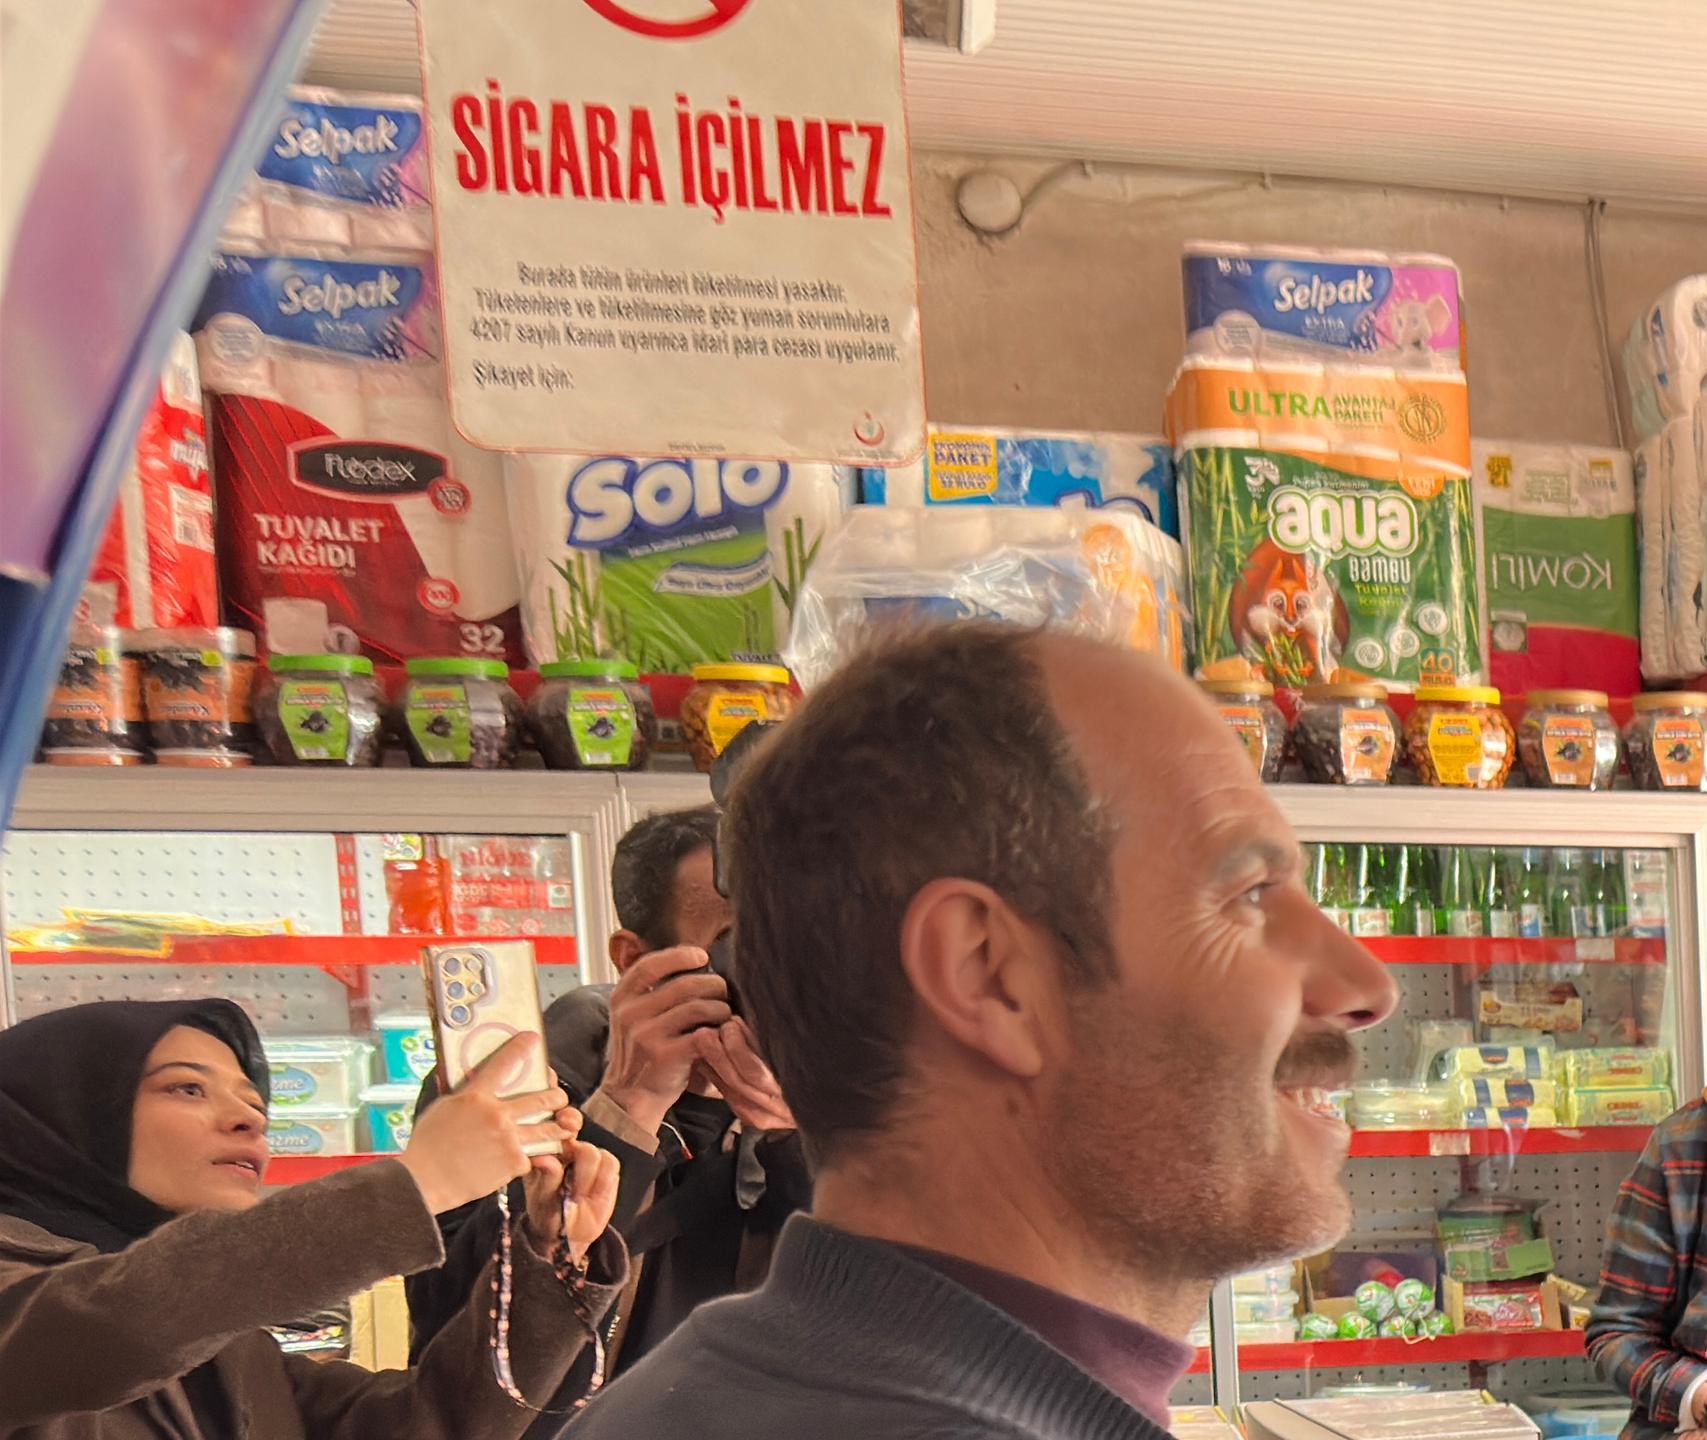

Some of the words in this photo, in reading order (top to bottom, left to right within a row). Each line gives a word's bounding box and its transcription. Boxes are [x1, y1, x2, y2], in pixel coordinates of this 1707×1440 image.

[274, 113, 399, 166] Selpak
[452, 76, 667, 206] SİGARA
[674, 92, 893, 225] İÇİLMEZ
[277, 268, 402, 319] Selpak
[517, 261, 577, 288] Burada
[579, 264, 623, 291] tütün
[625, 267, 689, 296] ürünleri
[691, 271, 779, 300] tüketilmesi
[1273, 269, 1376, 314] Selpak
[575, 299, 597, 319] ve
[708, 301, 739, 329] göz
[740, 306, 795, 332] yuman
[798, 306, 890, 334] sorumlulara
[469, 315, 512, 343] 4207
[515, 318, 562, 349] sayılı
[562, 321, 617, 350] Kanun
[618, 327, 690, 354] uyarınca
[691, 329, 731, 354] idari
[732, 333, 770, 360] para
[771, 334, 822, 359] cezası
[824, 335, 901, 364] uygulanır.
[472, 357, 537, 391] Şikayet
[1227, 387, 1333, 421] ULTRA
[934, 451, 993, 467] PAKET
[253, 511, 386, 545] TUVALET
[1274, 491, 1414, 554] aqua
[257, 537, 358, 571] KAĞIDI
[458, 622, 507, 654] 32
[1422, 650, 1455, 673] 40
